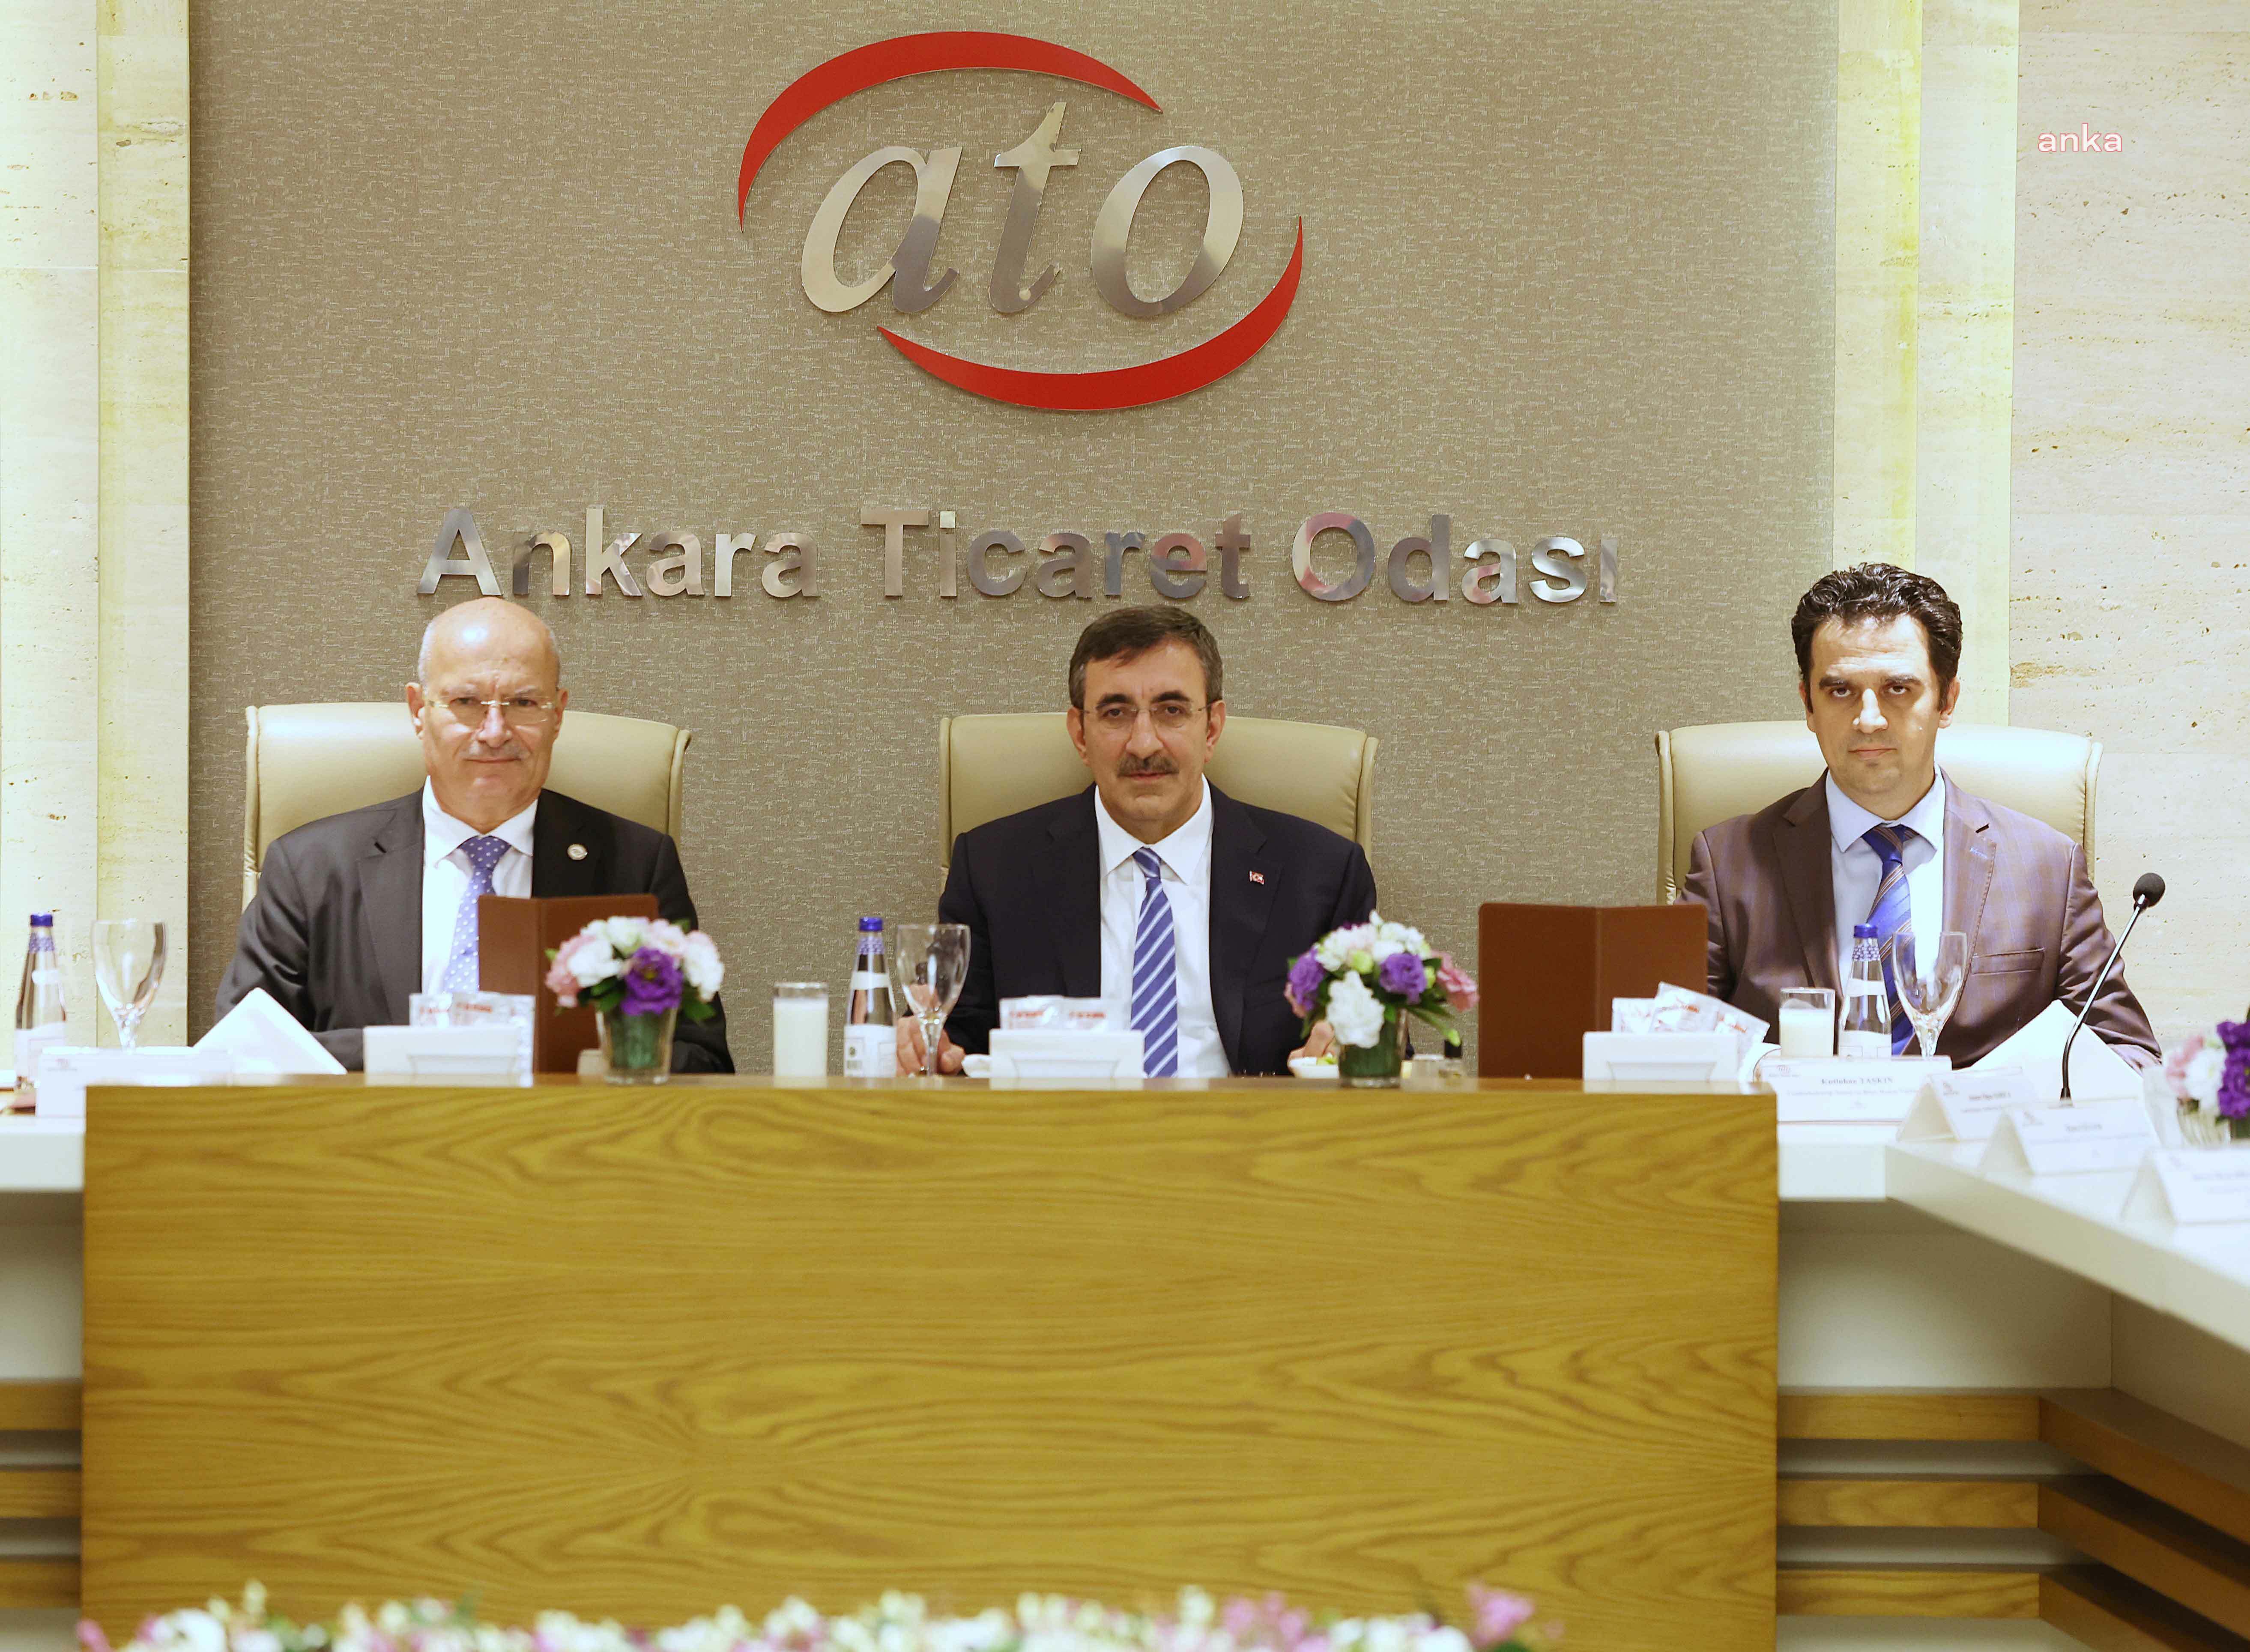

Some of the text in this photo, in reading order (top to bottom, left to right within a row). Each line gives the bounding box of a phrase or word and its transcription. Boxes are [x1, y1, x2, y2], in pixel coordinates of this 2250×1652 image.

[801, 102, 1244, 317] ato
[417, 507, 1619, 604] Ankara Ticaret Odası
